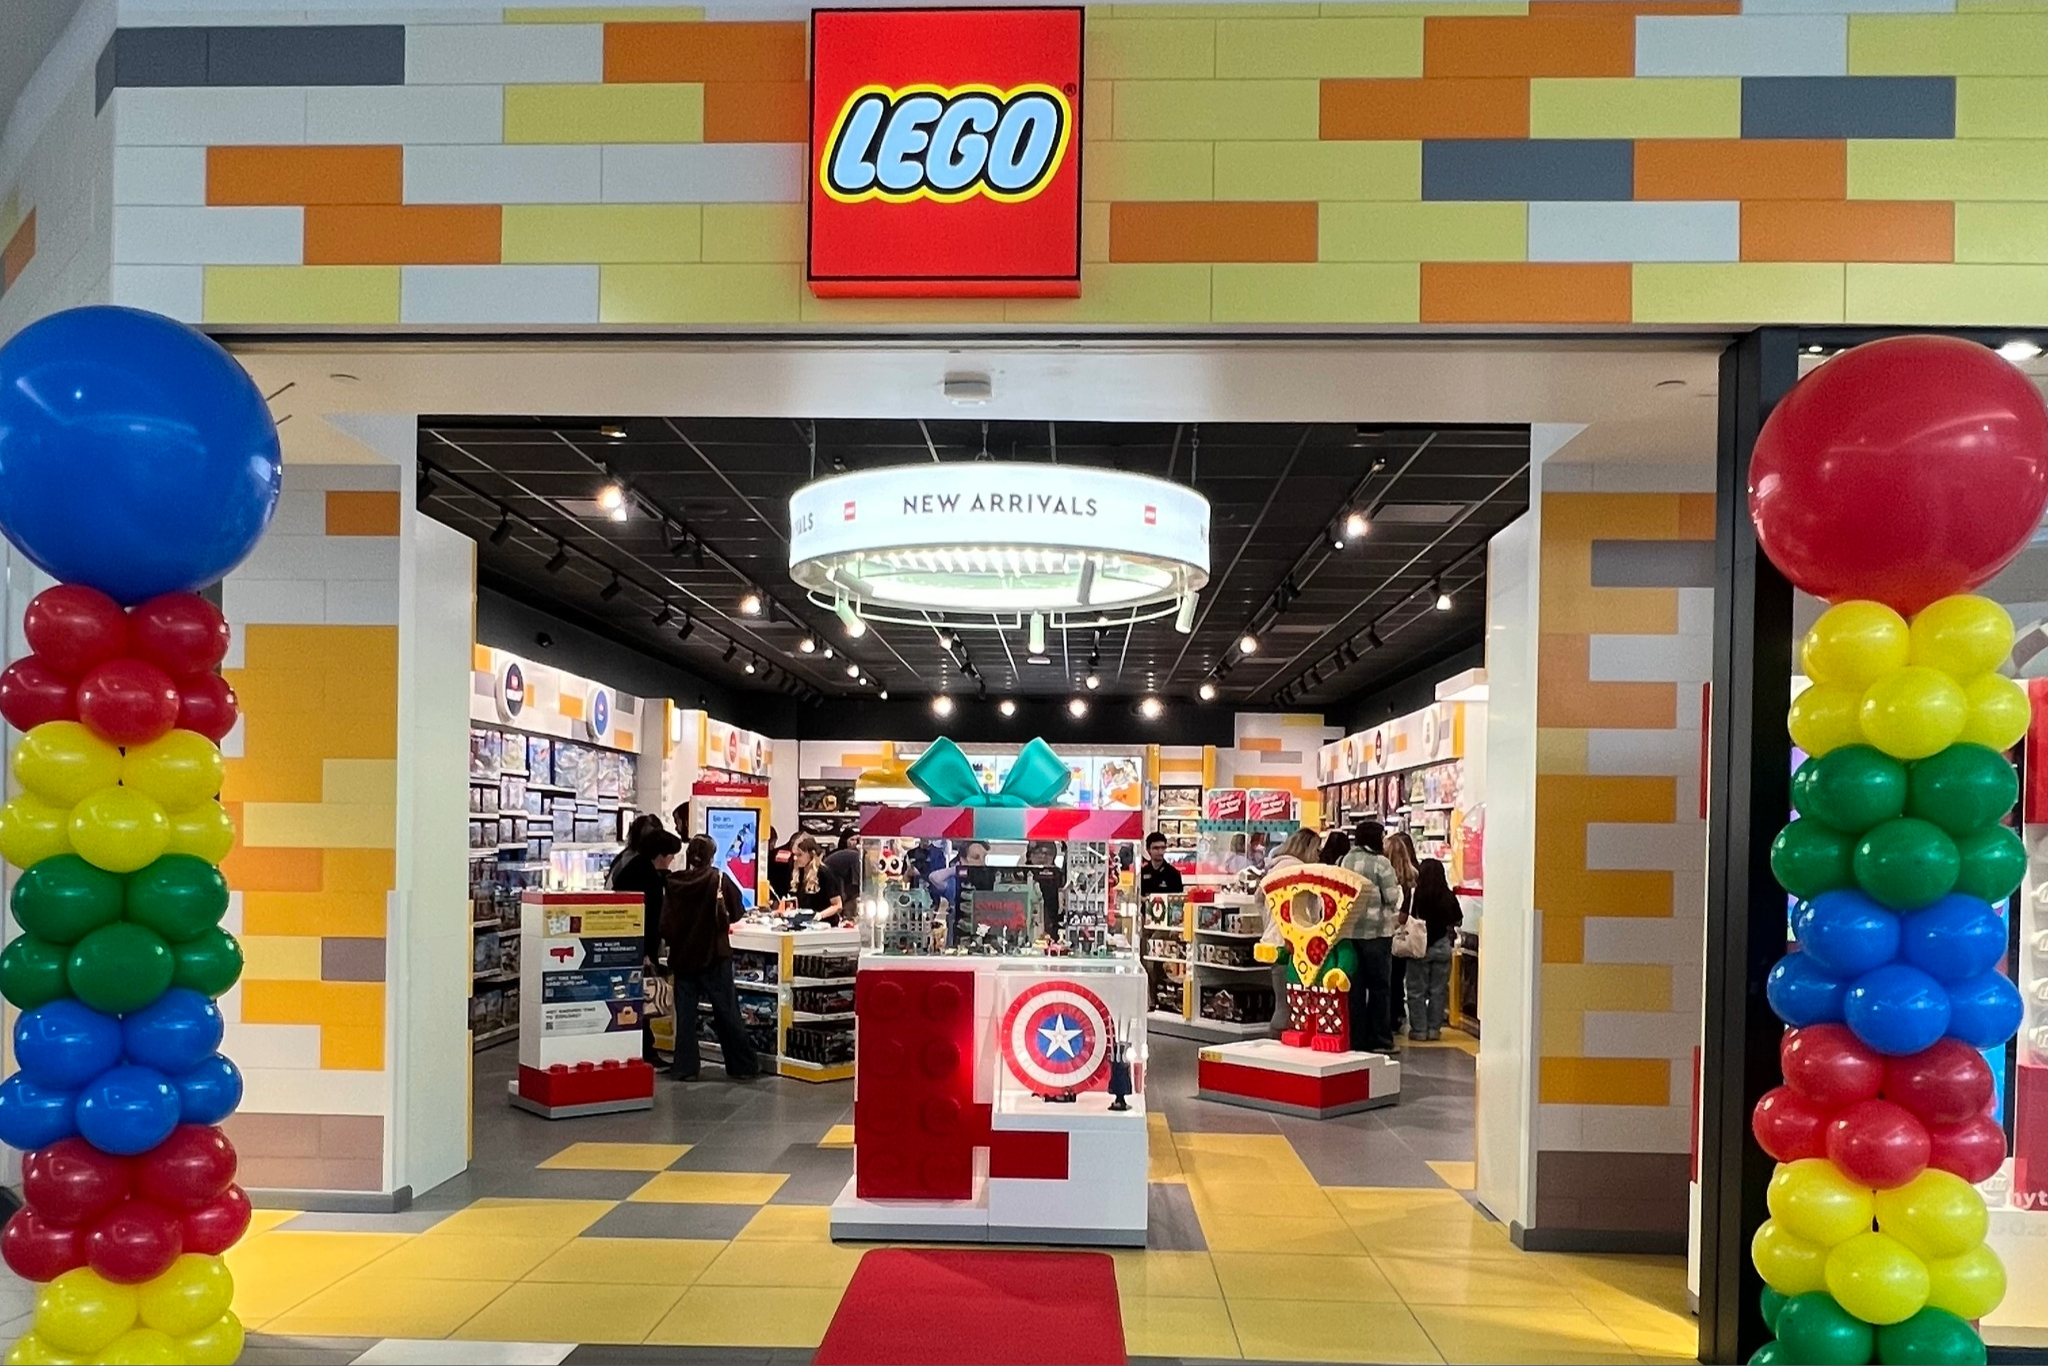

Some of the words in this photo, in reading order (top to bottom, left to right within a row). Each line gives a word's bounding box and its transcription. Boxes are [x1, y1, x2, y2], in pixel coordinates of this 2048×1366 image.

[824, 88, 1068, 199] LEGO
[903, 493, 961, 516] NEW
[970, 493, 1098, 516] ARRIVALS
